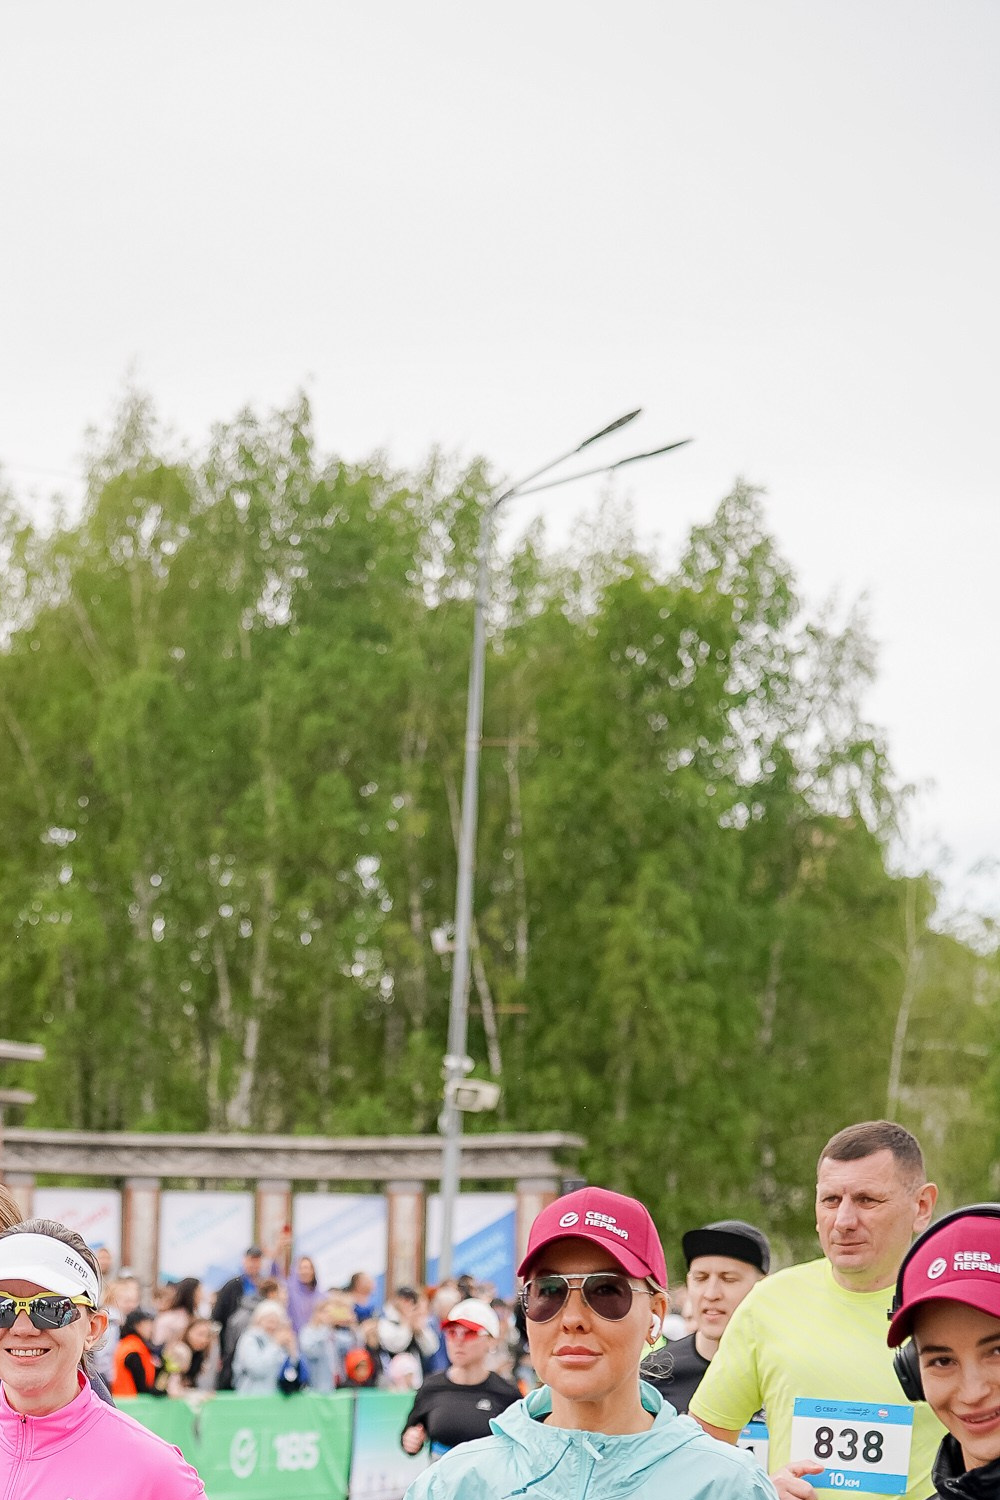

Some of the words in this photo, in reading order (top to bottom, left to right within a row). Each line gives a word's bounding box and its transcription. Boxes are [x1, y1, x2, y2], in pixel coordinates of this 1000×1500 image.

[585, 1211, 616, 1224] СБЕР
[584, 1218, 629, 1240] ПЕРВЫЙ
[954, 1251, 991, 1261] СБЕР
[953, 1261, 1000, 1275] ПЕРВЫ
[814, 1426, 884, 1463] 838
